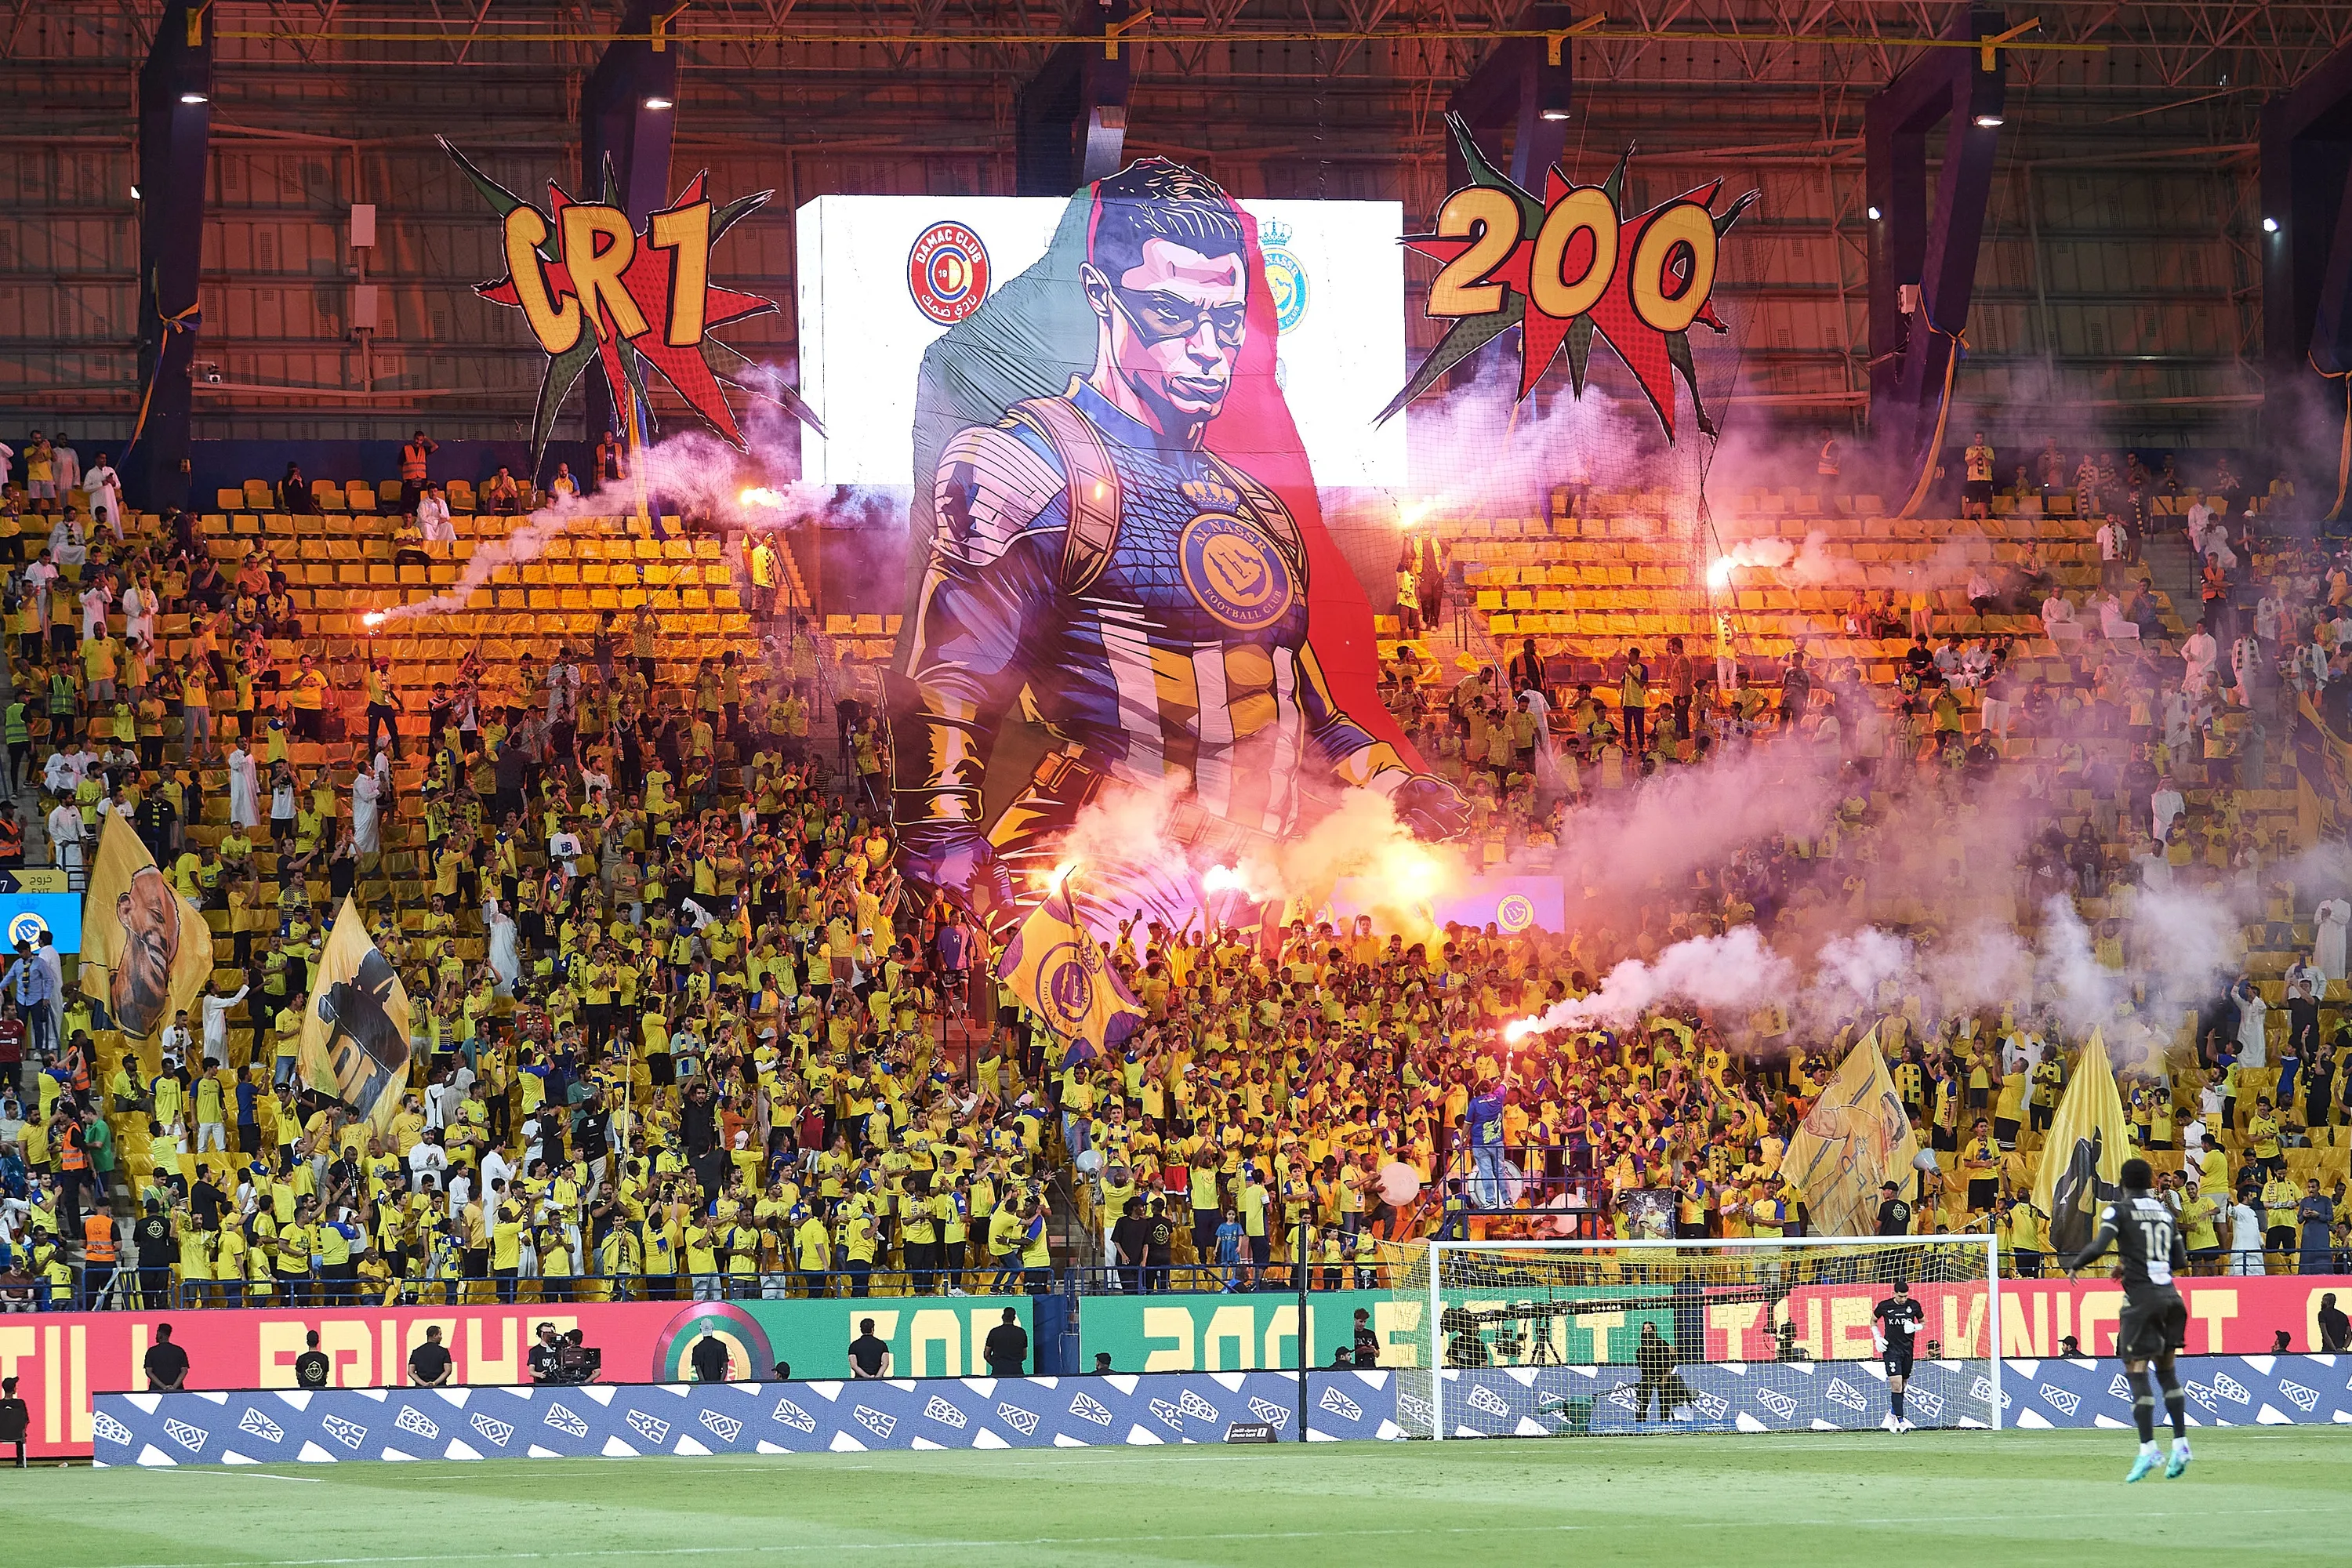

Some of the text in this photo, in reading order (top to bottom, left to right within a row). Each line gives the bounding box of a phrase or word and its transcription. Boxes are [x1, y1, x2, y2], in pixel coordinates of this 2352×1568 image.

[915, 229, 982, 264] DAMAC CLUB
[1427, 187, 1717, 332] 200
[938, 269, 948, 278] 19
[954, 294, 978, 318] نادي
[1192, 521, 1267, 554] AL NASSR
[1203, 588, 1283, 619] FOOTBALL CLUB
[0, 880, 8, 892] 7
[30, 874, 53, 885] خروج
[2140, 1221, 2171, 1261] 10
[60, 1272, 67, 1281] 7
